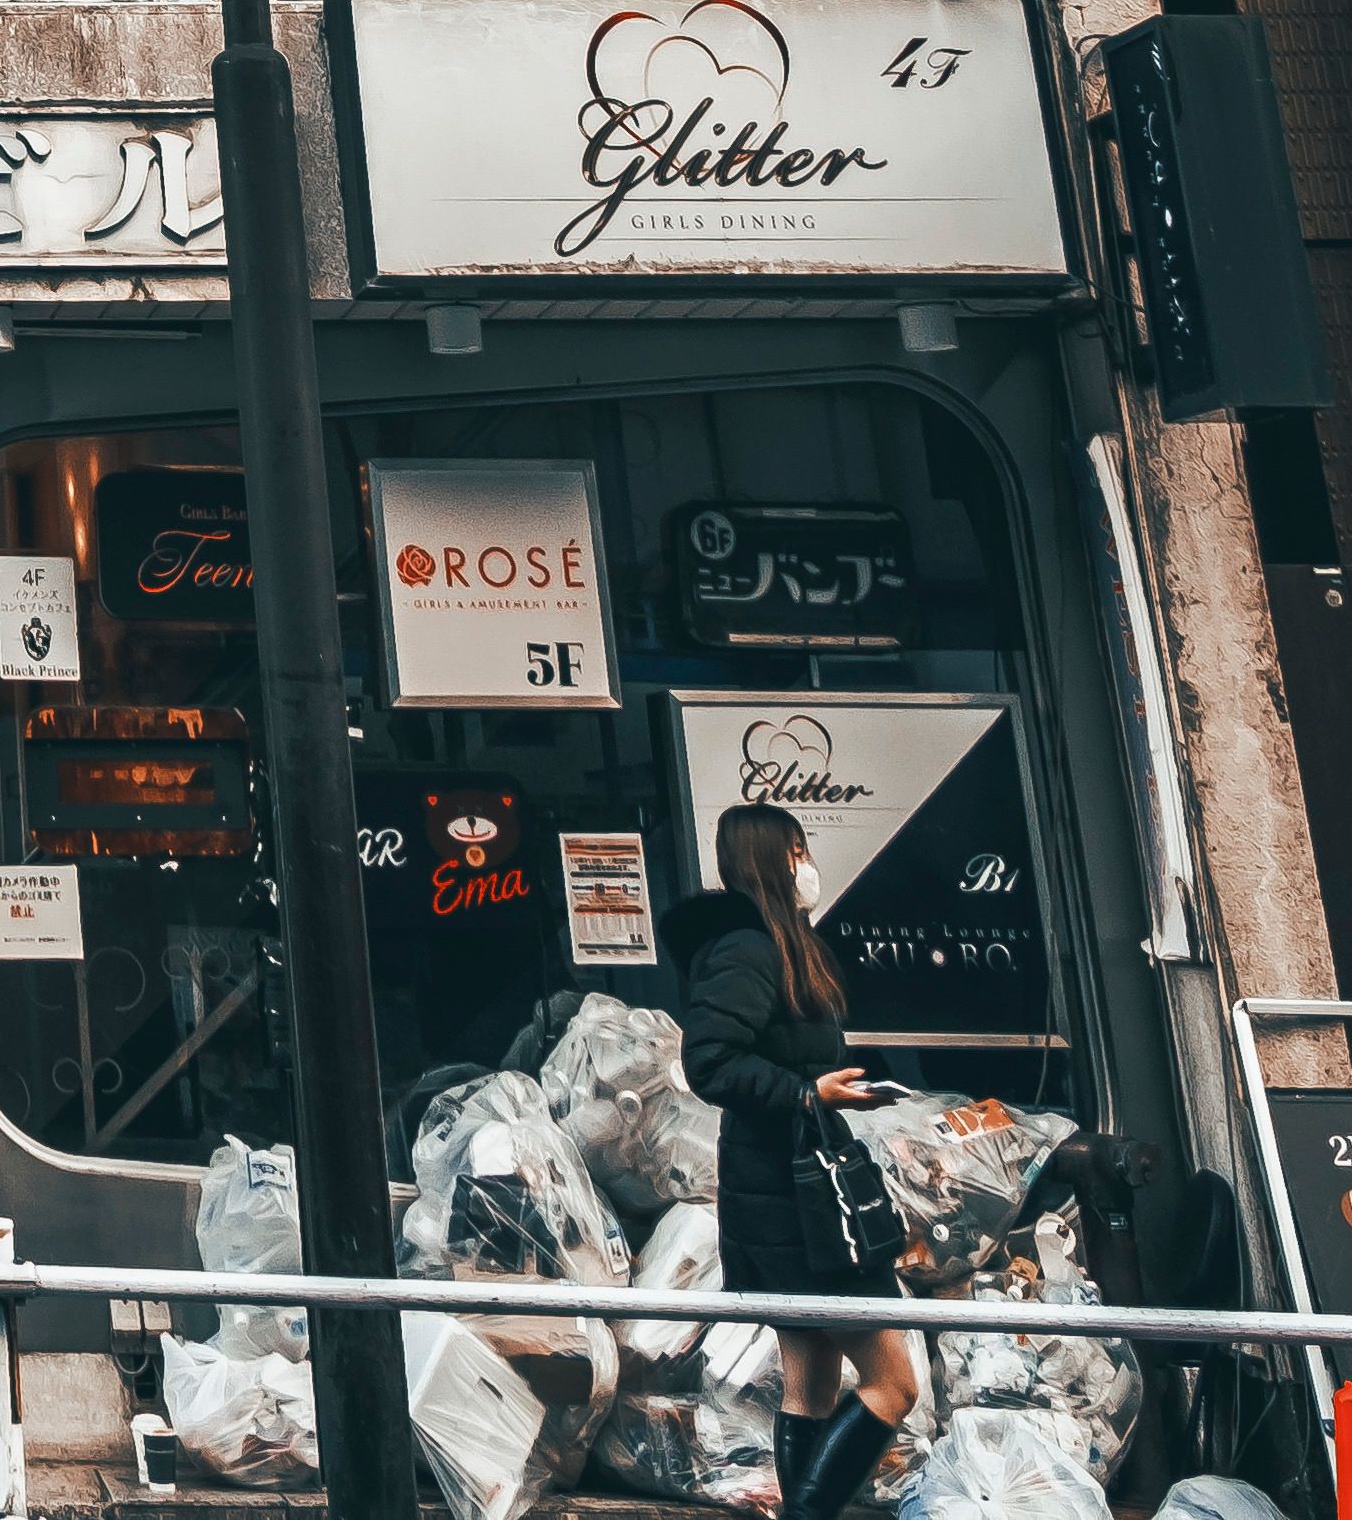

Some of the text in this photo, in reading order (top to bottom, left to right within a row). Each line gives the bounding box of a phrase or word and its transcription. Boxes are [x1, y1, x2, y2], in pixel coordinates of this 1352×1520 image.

[882, 38, 971, 91] 4F
[555, 95, 888, 258] Glitter
[631, 214, 817, 231] GIRLS DINING
[22, 569, 45, 586] 4F
[444, 538, 585, 588] ROSÉ
[2, 665, 78, 677] Black Prince
[527, 641, 585, 687] 5F
[432, 859, 529, 915] Ema
[840, 922, 925, 940] Dining
[1329, 1135, 1352, 1167] 2
